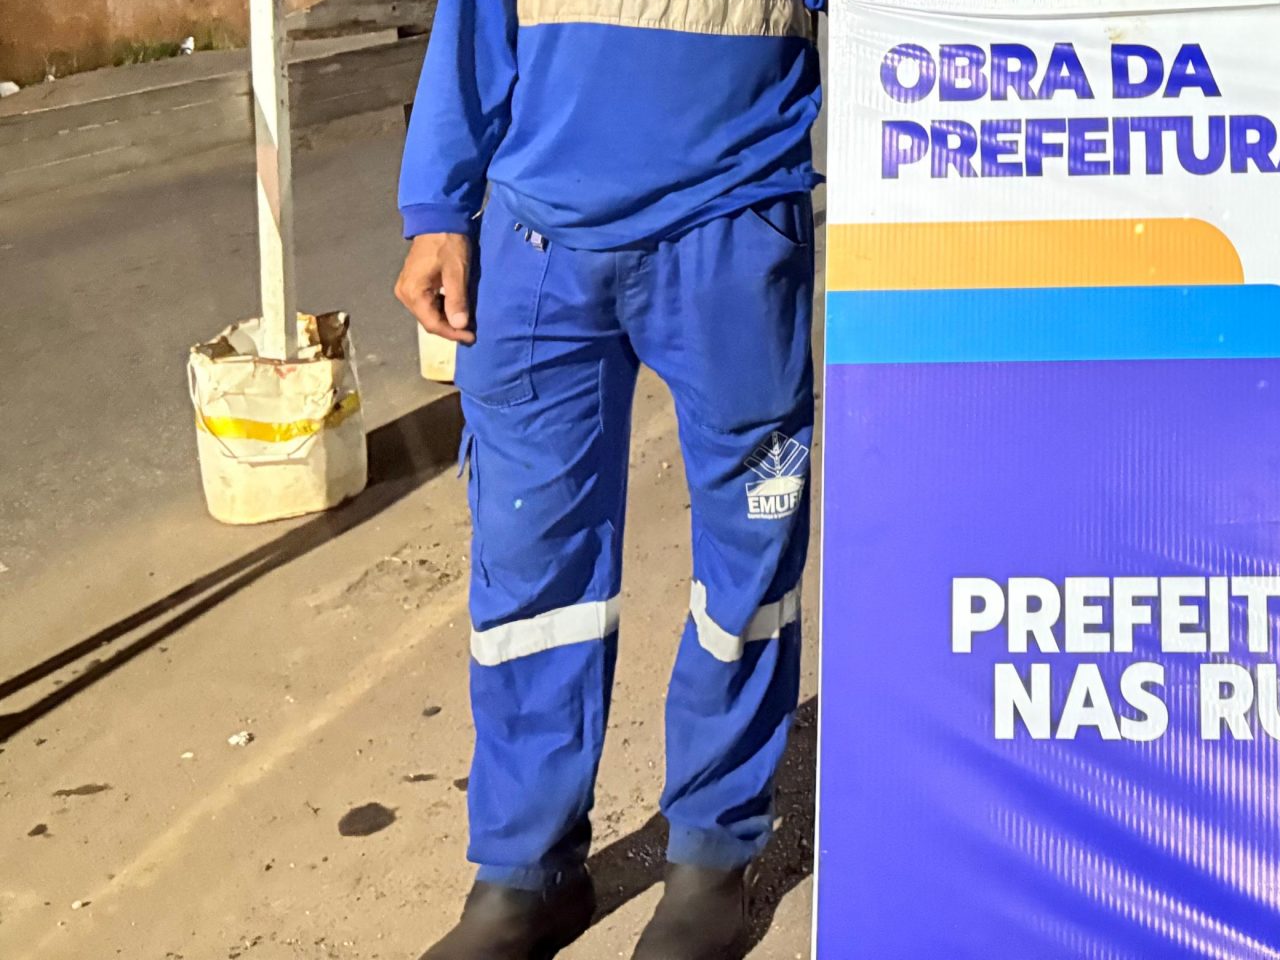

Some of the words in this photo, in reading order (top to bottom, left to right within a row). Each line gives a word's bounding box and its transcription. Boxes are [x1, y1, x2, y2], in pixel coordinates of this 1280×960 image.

[880, 42, 1095, 103] OBRA
[1111, 43, 1222, 99] DA
[994, 661, 1169, 742] NAS
